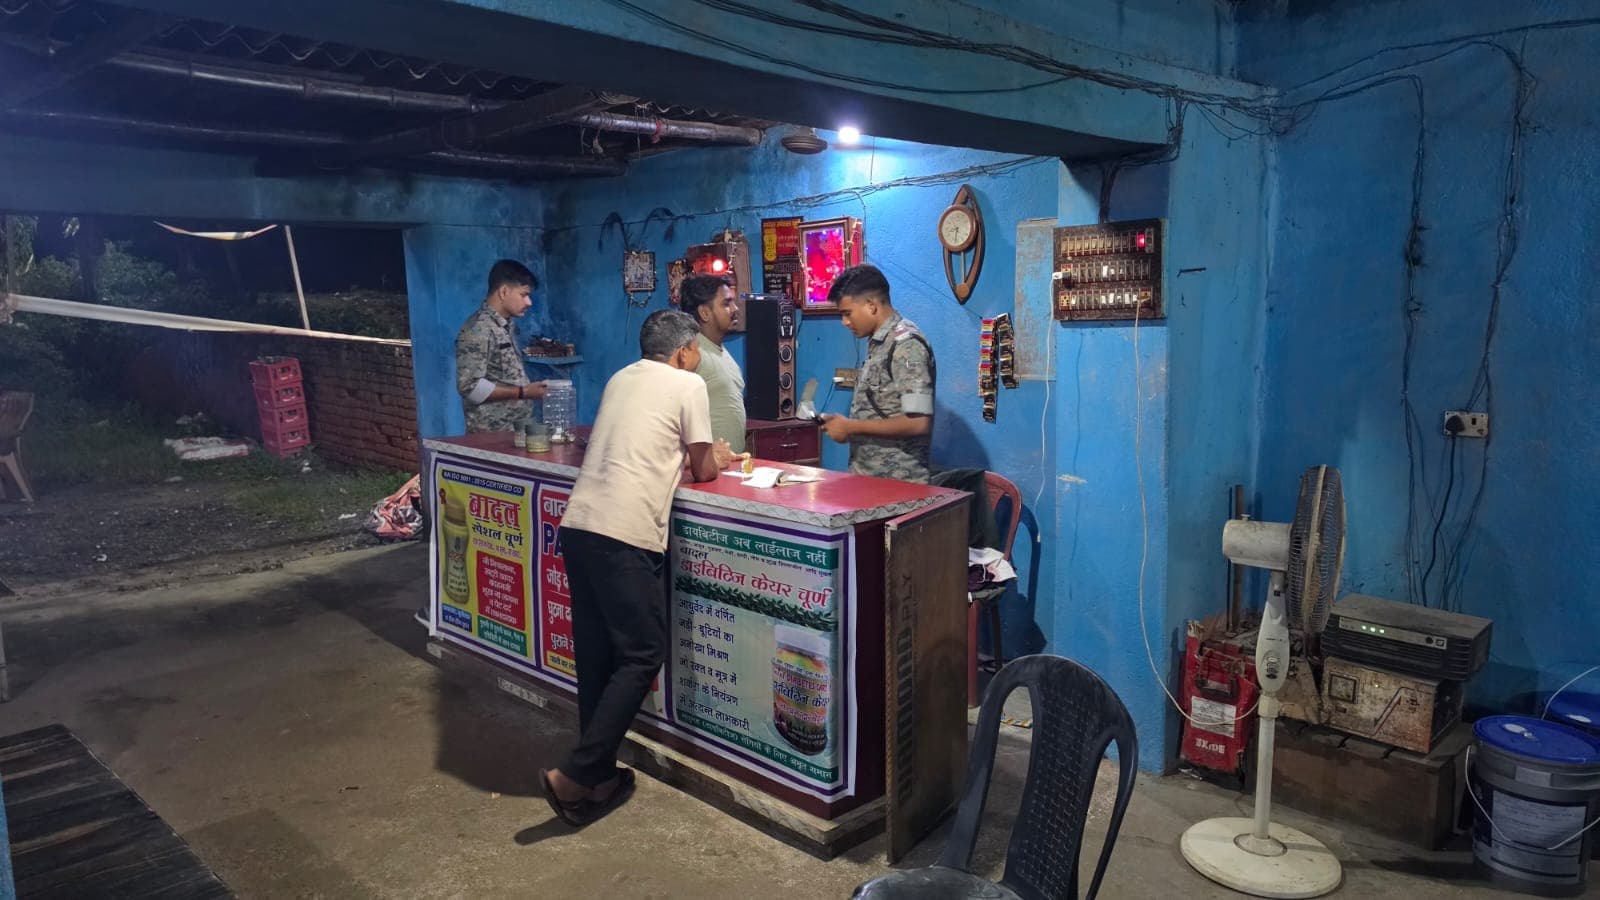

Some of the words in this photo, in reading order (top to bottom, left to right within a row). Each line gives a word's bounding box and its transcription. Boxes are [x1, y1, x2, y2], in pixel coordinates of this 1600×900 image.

[469, 493, 521, 530] बादल
[472, 522, 502, 541] स्पेशल
[505, 533, 523, 548] चूर्ण
[543, 521, 563, 558] PA
[682, 525, 728, 545] डायबिटीज
[734, 537, 751, 550] अब
[755, 541, 801, 561] लाईलाज
[805, 550, 827, 566] नहीं
[680, 546, 709, 560] बादल
[546, 564, 562, 592] जोड़
[680, 559, 747, 586] डाइबिटिज
[751, 572, 793, 597] केयर
[798, 588, 833, 610] चूर्ण
[680, 599, 704, 615] आयुर्वेद
[715, 607, 735, 623] वर्णित
[699, 623, 721, 640] बूटियों
[724, 631, 734, 644] का
[707, 643, 729, 662] मिश्रण
[690, 661, 706, 675] रक्त
[708, 667, 713, 677] व
[715, 669, 728, 684] मूत्र
[702, 682, 710, 694] के
[711, 685, 739, 707] नियंत्रण
[715, 710, 750, 731] लाभकारी
[1195, 738, 1226, 754] EXIDE
[773, 747, 788, 762] लिए
[810, 766, 833, 780] समान
